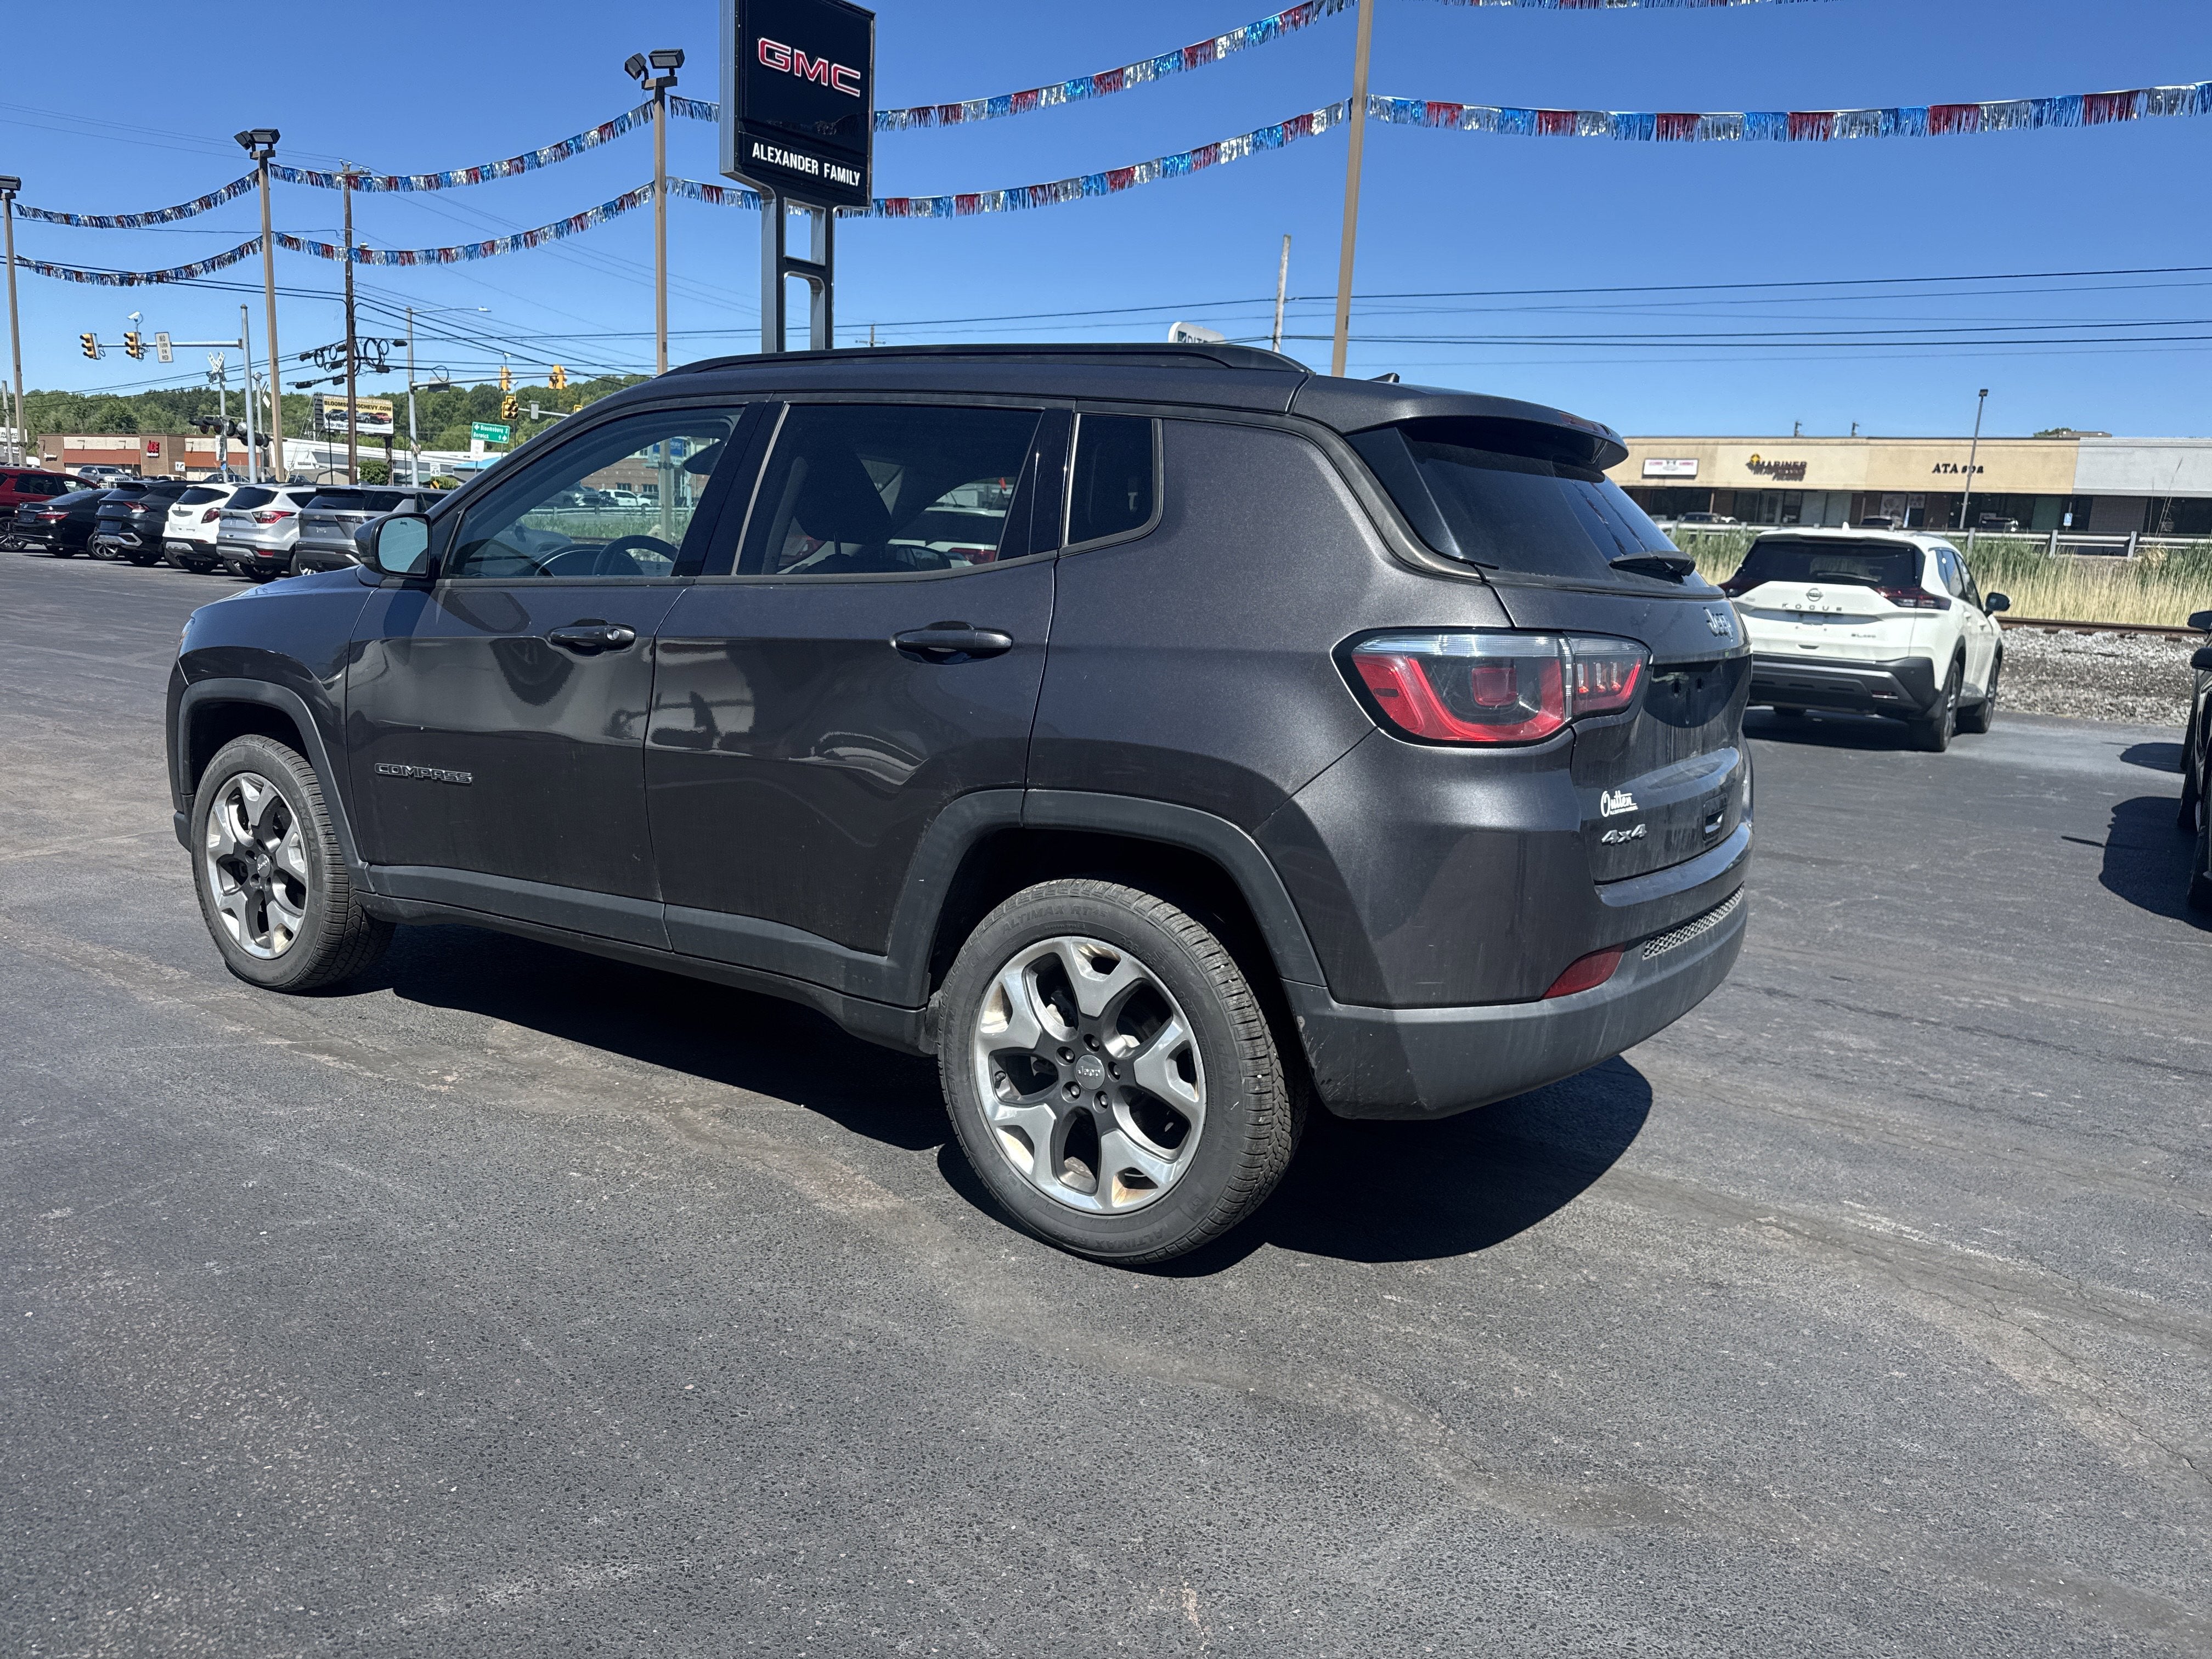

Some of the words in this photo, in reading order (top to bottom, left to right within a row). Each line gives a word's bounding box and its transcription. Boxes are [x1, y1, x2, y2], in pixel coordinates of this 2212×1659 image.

[758, 37, 860, 98] GMC
[752, 142, 819, 176] ALEXANDER
[824, 163, 860, 187] FAMILY
[480, 425, 504, 434] Bloomsburg
[147, 441, 159, 452] ACE
[1931, 462, 1959, 473] ATA
[1782, 603, 1842, 612] ROGUE
[374, 763, 473, 783] COMPASS
[1600, 790, 1637, 817] Outten
[1601, 823, 1647, 844] 4x4
[1002, 905, 1064, 934] ALTIMAX
